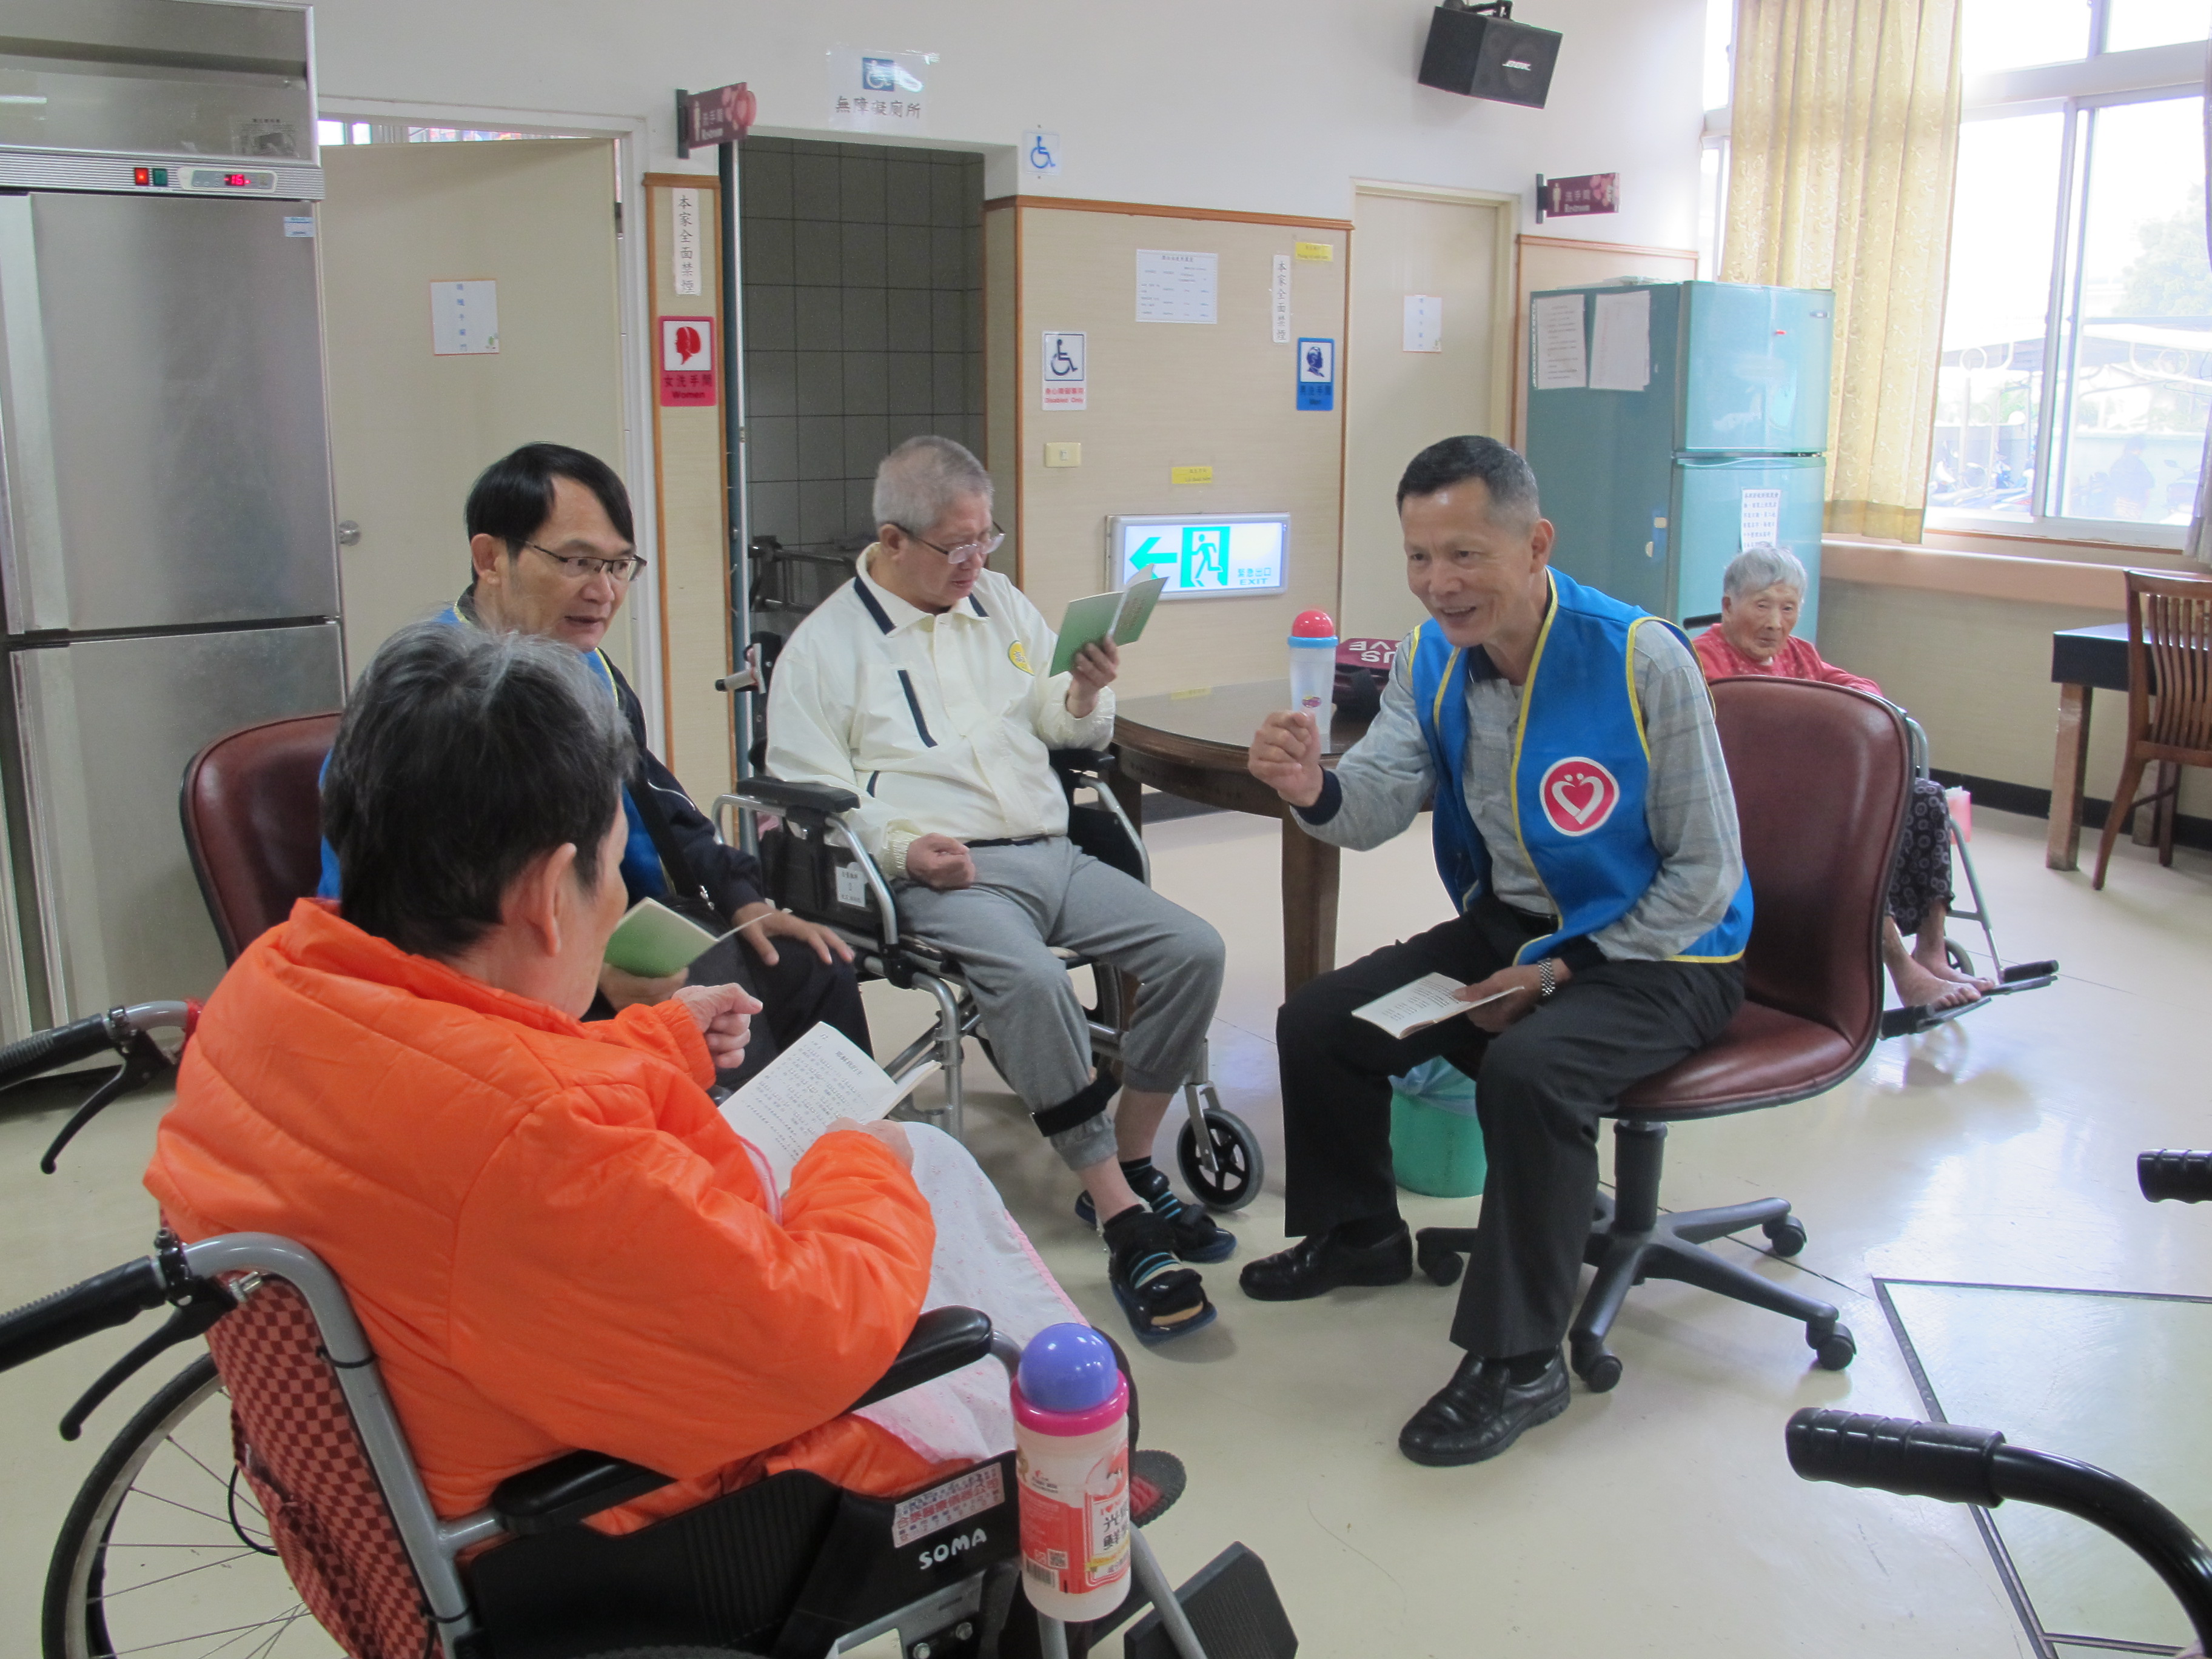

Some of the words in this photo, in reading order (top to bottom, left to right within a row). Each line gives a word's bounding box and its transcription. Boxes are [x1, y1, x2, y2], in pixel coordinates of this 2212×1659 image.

[835, 96, 920, 118] 無障礙廁所
[678, 195, 695, 293] 本家全面禁煙
[664, 374, 712, 387] 女洗手間
[1238, 567, 1272, 577] 緊急出口
[1349, 640, 1402, 651] VE
[918, 1527, 988, 1570] SOMA
